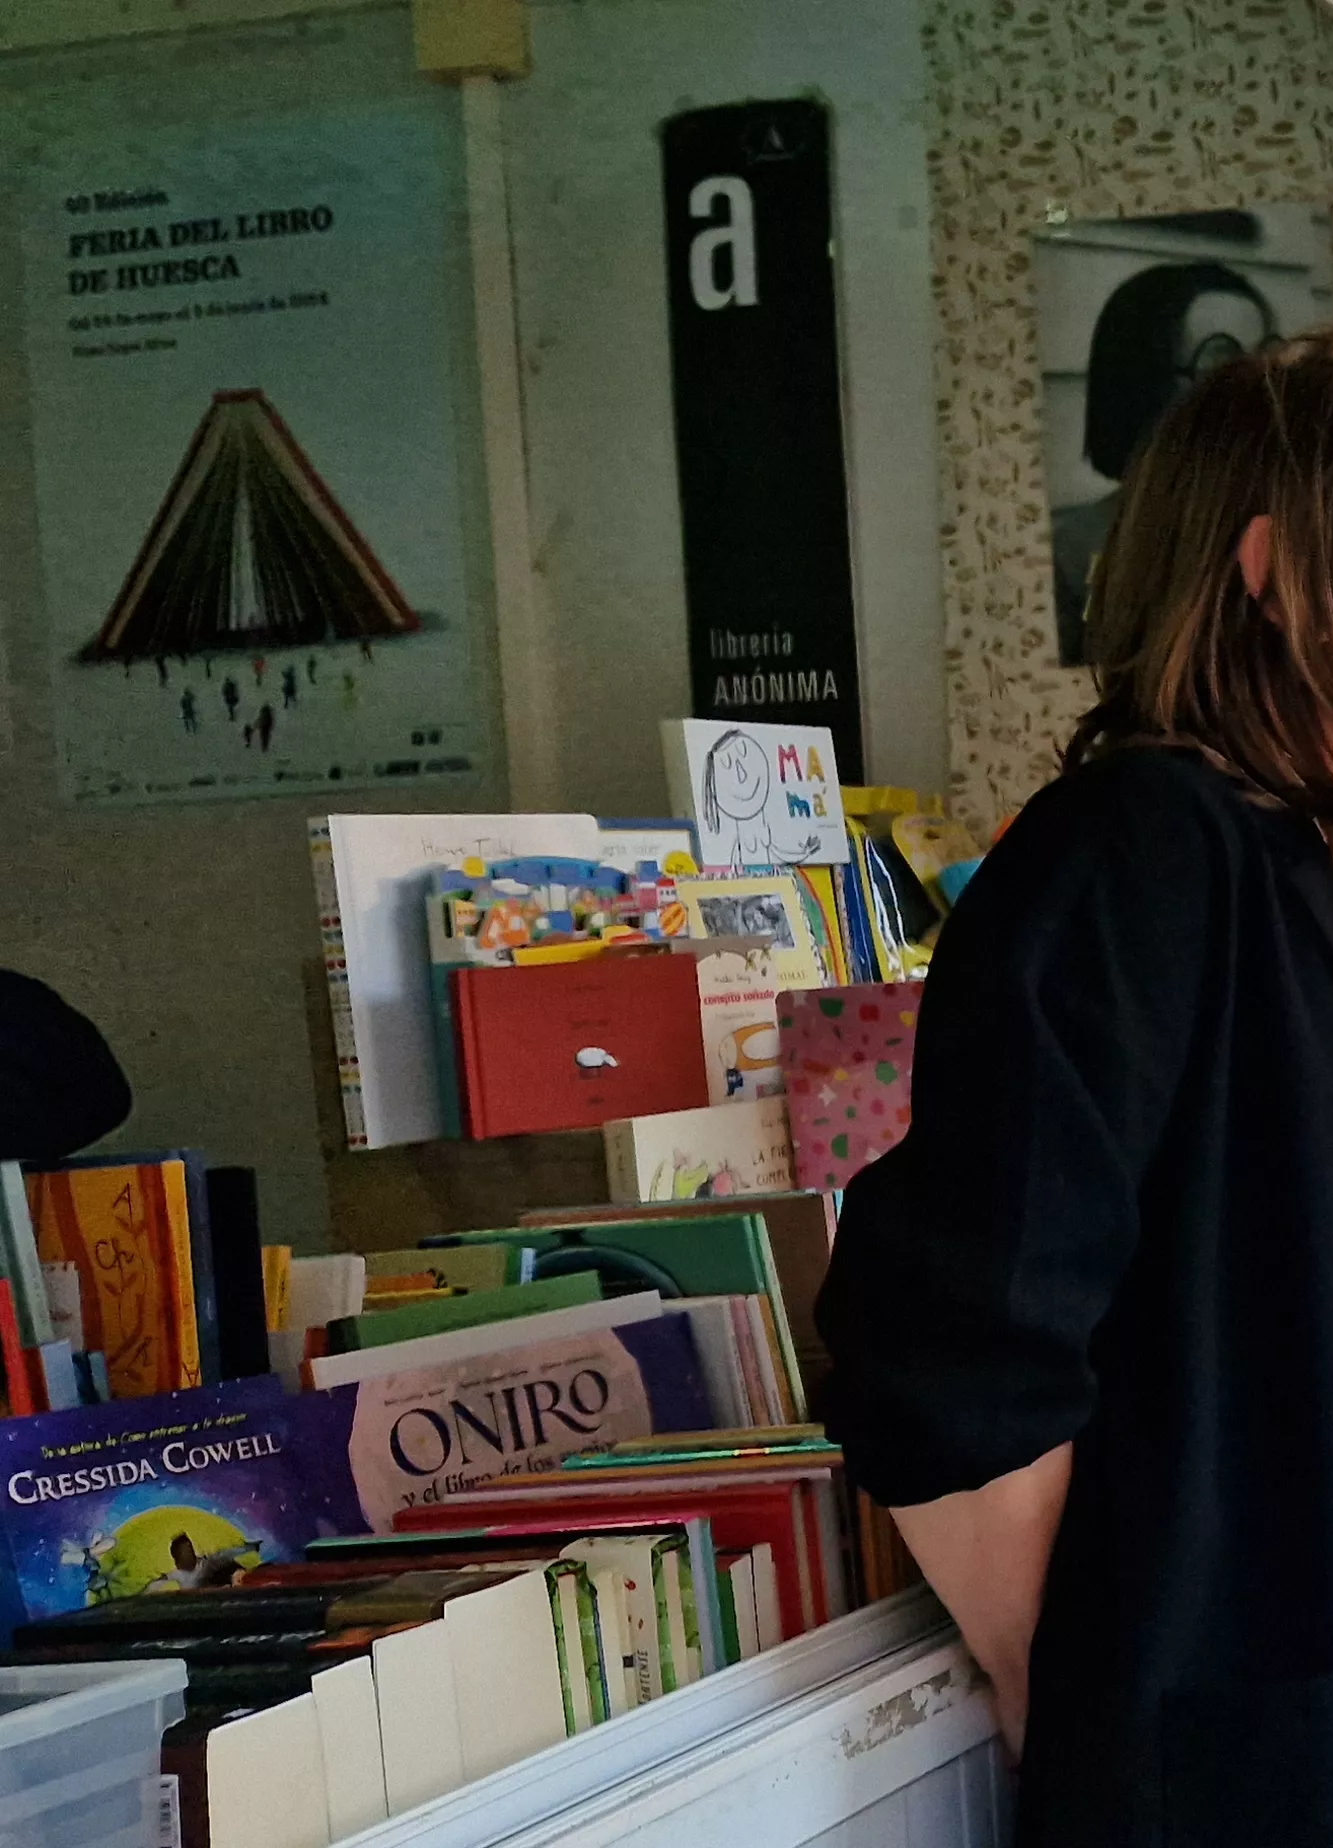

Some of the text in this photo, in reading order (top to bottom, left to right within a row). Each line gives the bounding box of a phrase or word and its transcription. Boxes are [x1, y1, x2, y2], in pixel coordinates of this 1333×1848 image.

[69, 204, 333, 257] FERIA DEL LIBRO
[688, 174, 760, 310] a
[69, 254, 241, 295] DE HUESCA
[714, 665, 838, 706] ANÓNIMA
[778, 744, 825, 784] MA
[390, 1369, 609, 1476] ONIRO
[8, 1433, 282, 1506] CRESSIDA COWELL
